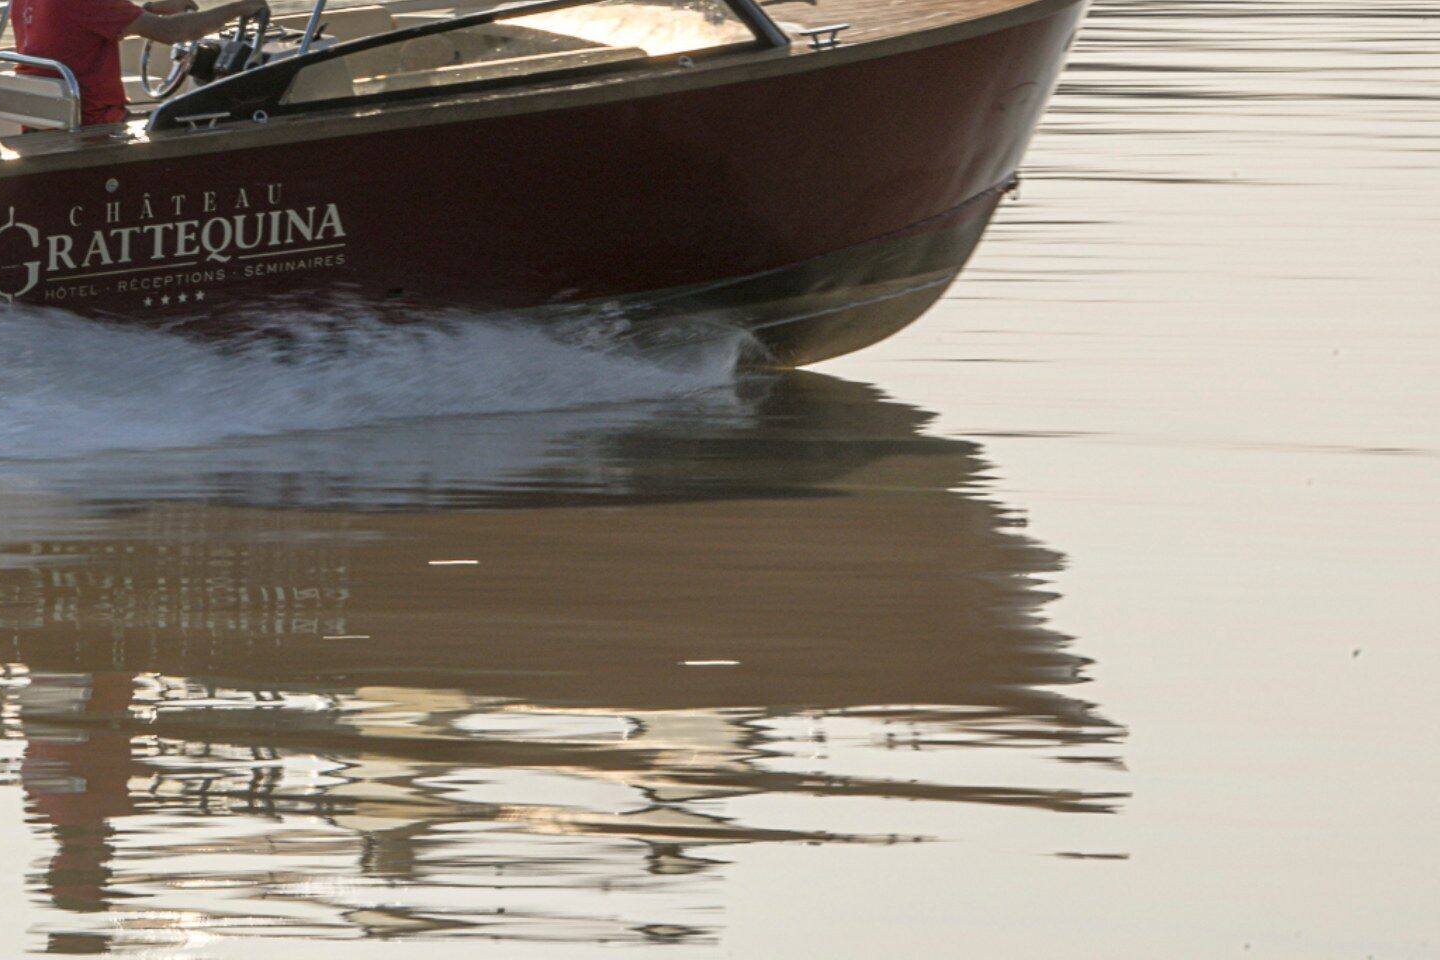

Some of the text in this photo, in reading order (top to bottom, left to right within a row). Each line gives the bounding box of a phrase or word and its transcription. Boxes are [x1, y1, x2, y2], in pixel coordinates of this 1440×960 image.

[68, 182, 284, 228] CHÂTEAU
[117, 269, 227, 292] RÉCEPTIONS
[243, 253, 346, 278] SÉMINAIRES
